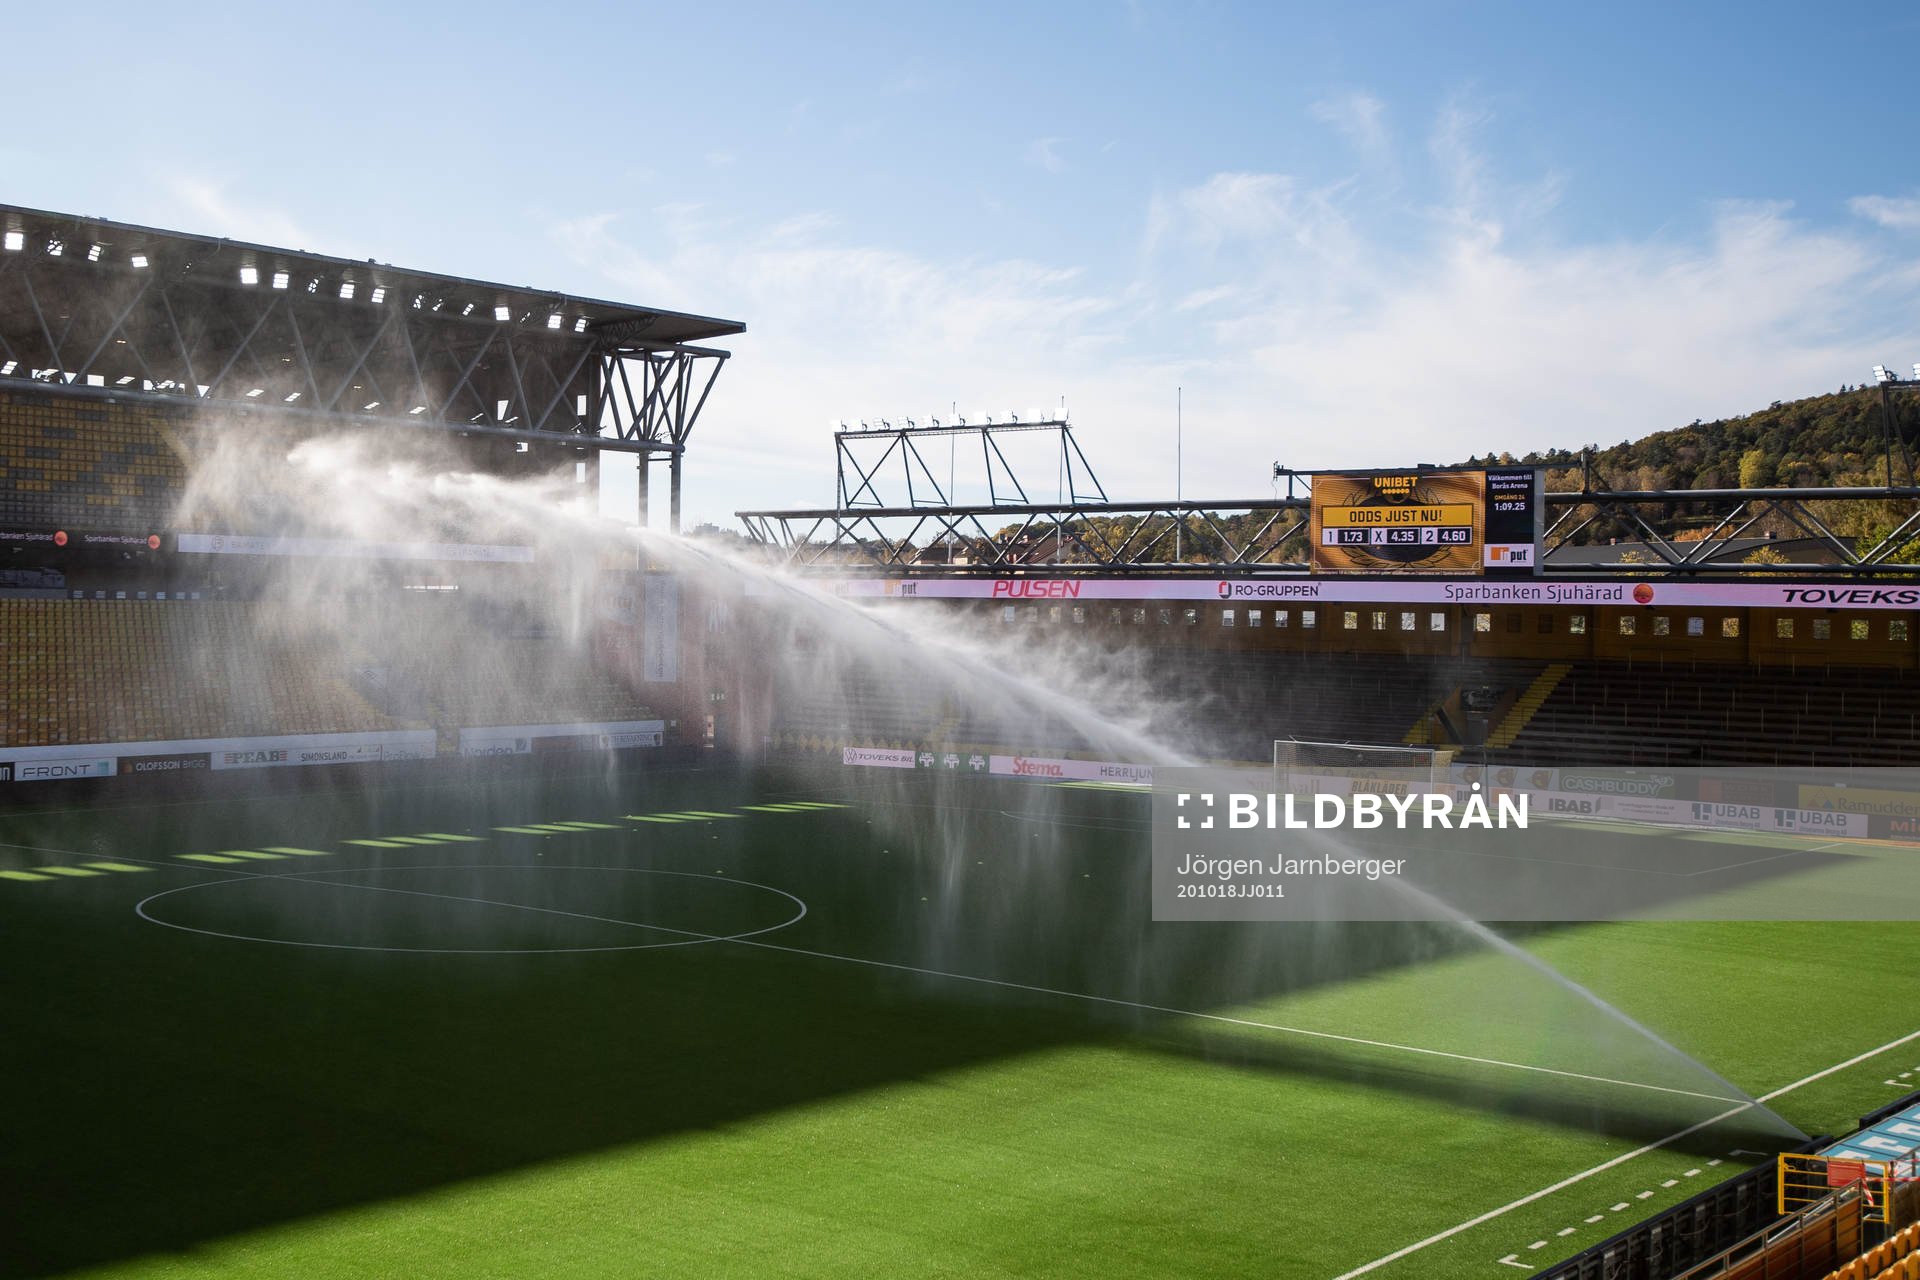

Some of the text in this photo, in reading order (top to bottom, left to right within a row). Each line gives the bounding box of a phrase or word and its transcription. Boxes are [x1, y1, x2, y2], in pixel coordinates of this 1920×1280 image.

[1374, 476, 1418, 488] UNIBET
[1494, 503, 1526, 511] 1:09.25
[1349, 510, 1443, 523] ODDS JUST NU!
[1328, 531, 1466, 543] 1 1.73 X 4.35 2 4.60
[992, 580, 1081, 597] PULSEN
[1235, 585, 1319, 597] RO-GRUPPEN
[1445, 584, 1623, 602] Sparbanken Sjuhärad
[1782, 589, 1920, 604] TOVEKS
[232, 751, 281, 764] PEAB
[300, 751, 348, 762] SIMONSLAND
[858, 753, 899, 762] TOVEKS
[22, 764, 91, 777] FRONT
[1351, 779, 1408, 796] BLÅKLÄDER
[1563, 777, 1660, 796] CASHBUDDY
[1549, 798, 1592, 814] IBAB
[1716, 805, 1760, 819] UBAB
[1800, 812, 1848, 827] UBAB
